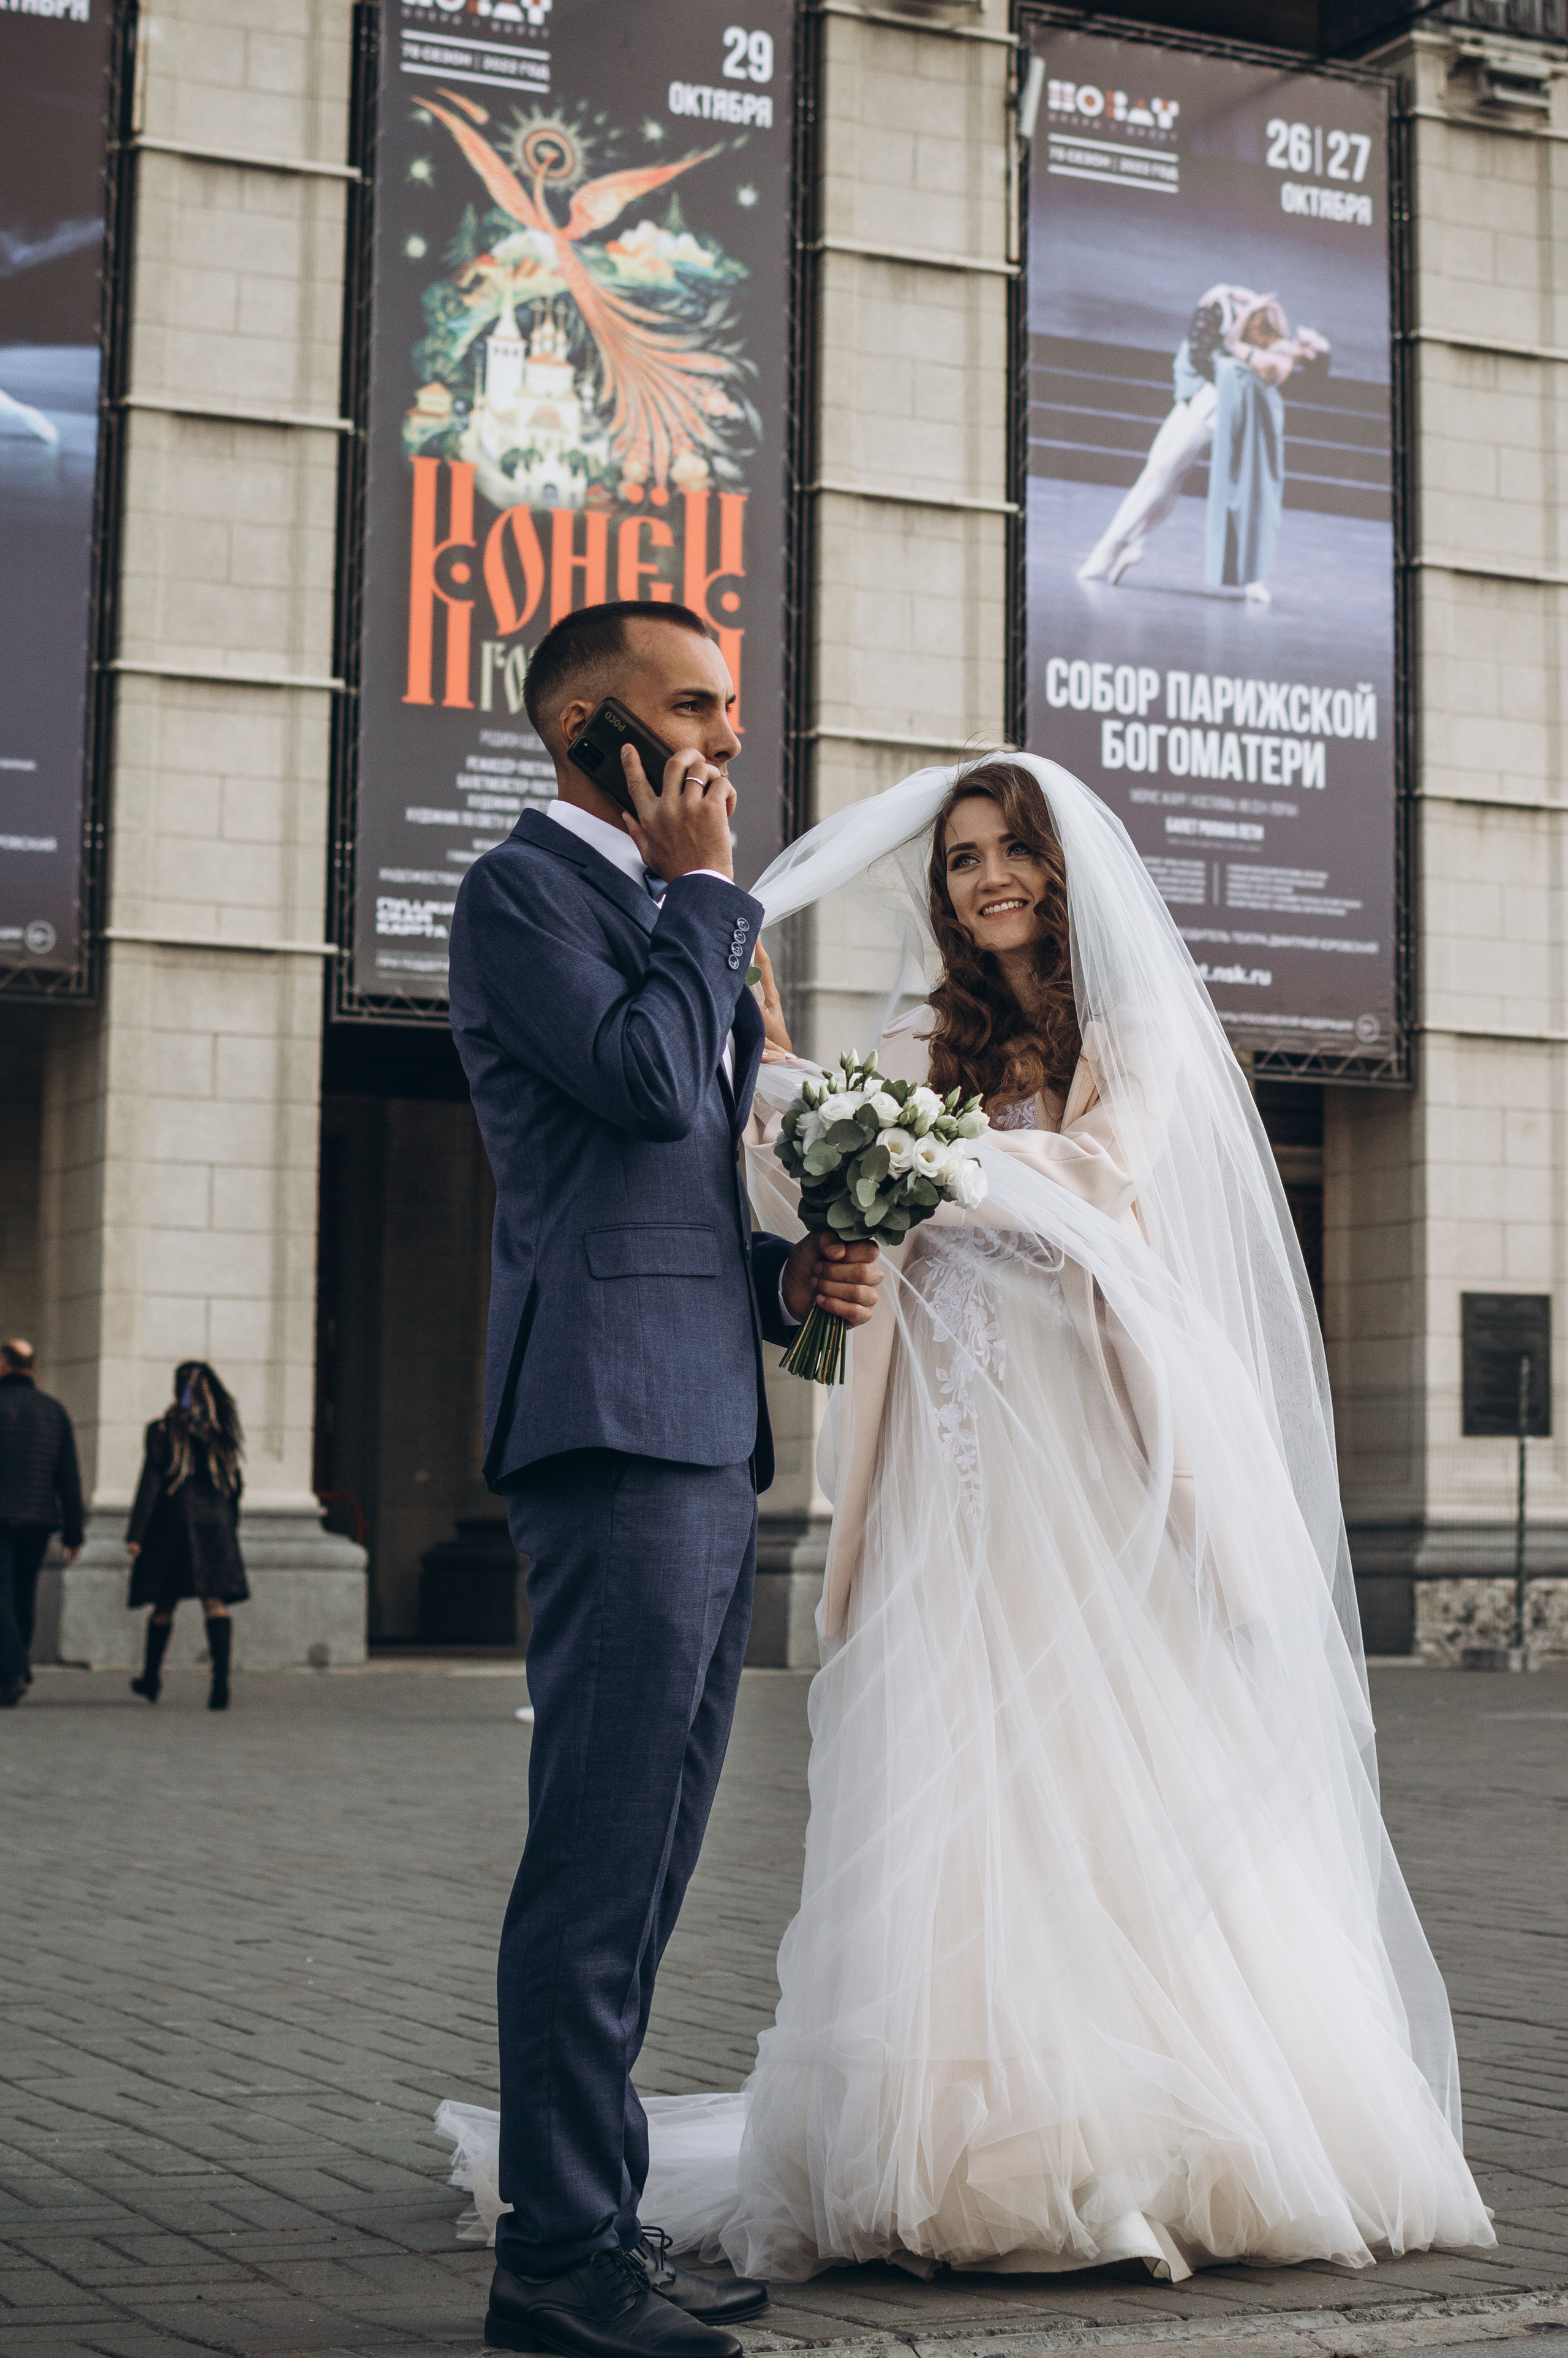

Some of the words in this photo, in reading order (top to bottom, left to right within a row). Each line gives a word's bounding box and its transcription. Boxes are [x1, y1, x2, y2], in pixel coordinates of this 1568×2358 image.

[722, 25, 774, 83] 29
[668, 81, 774, 129] ОКТЯБРЯ
[1281, 181, 1372, 226] ОКТЯБРЯ
[402, 456, 748, 734] КОНЁК
[605, 711, 626, 732] POCO
[1046, 657, 1160, 717] СОБОР
[1166, 671, 1377, 741] ПАРИЖСКОЙ
[1102, 719, 1326, 790] БОГОМАТЕРИ
[1194, 962, 1272, 986] t.nsk.ru
